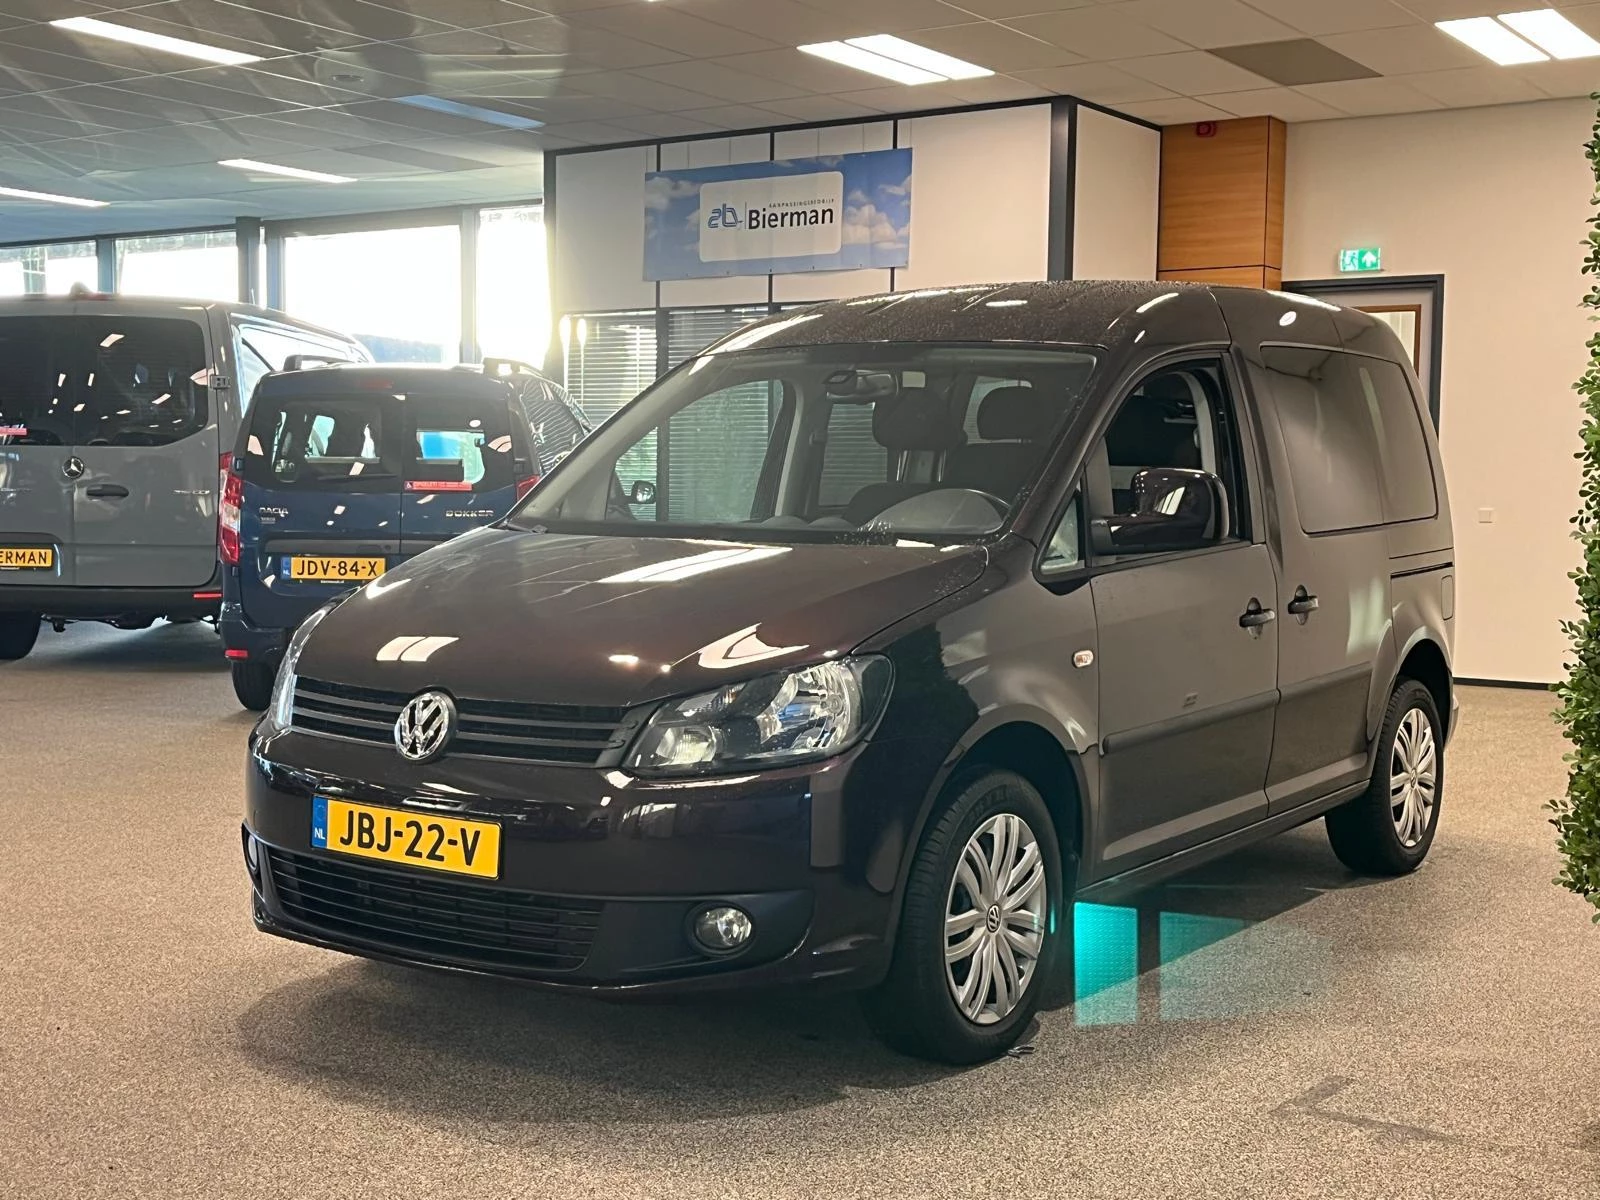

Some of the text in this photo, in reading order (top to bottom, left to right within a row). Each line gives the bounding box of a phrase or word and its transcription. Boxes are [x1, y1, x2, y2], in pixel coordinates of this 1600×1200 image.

[748, 207, 834, 230] Bierman
[445, 509, 494, 518] DOKKER
[297, 559, 378, 576] JDV-84-X
[314, 810, 480, 866] NL JBJ-22-V
